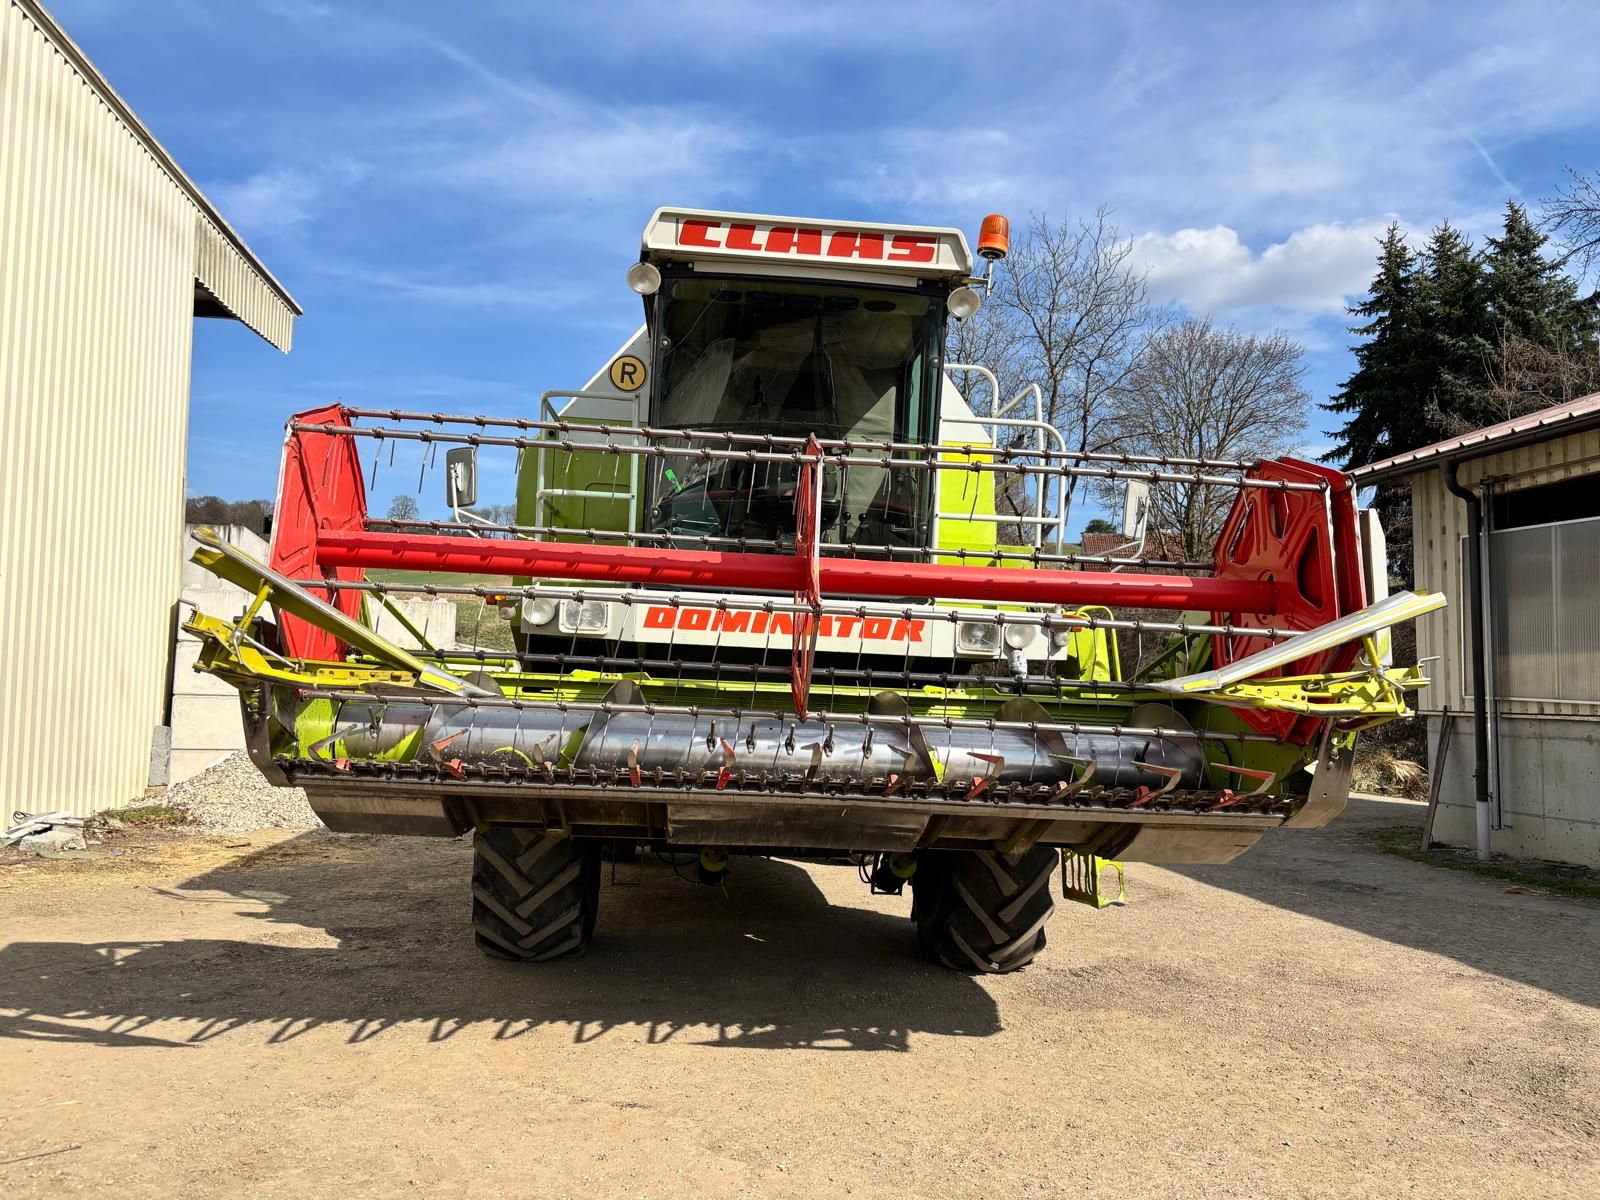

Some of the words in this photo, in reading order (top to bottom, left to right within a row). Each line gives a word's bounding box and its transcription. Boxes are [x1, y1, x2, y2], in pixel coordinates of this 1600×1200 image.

[679, 219, 937, 262] CLAAS
[620, 362, 637, 384] R
[643, 606, 926, 642] DOMINATOR
